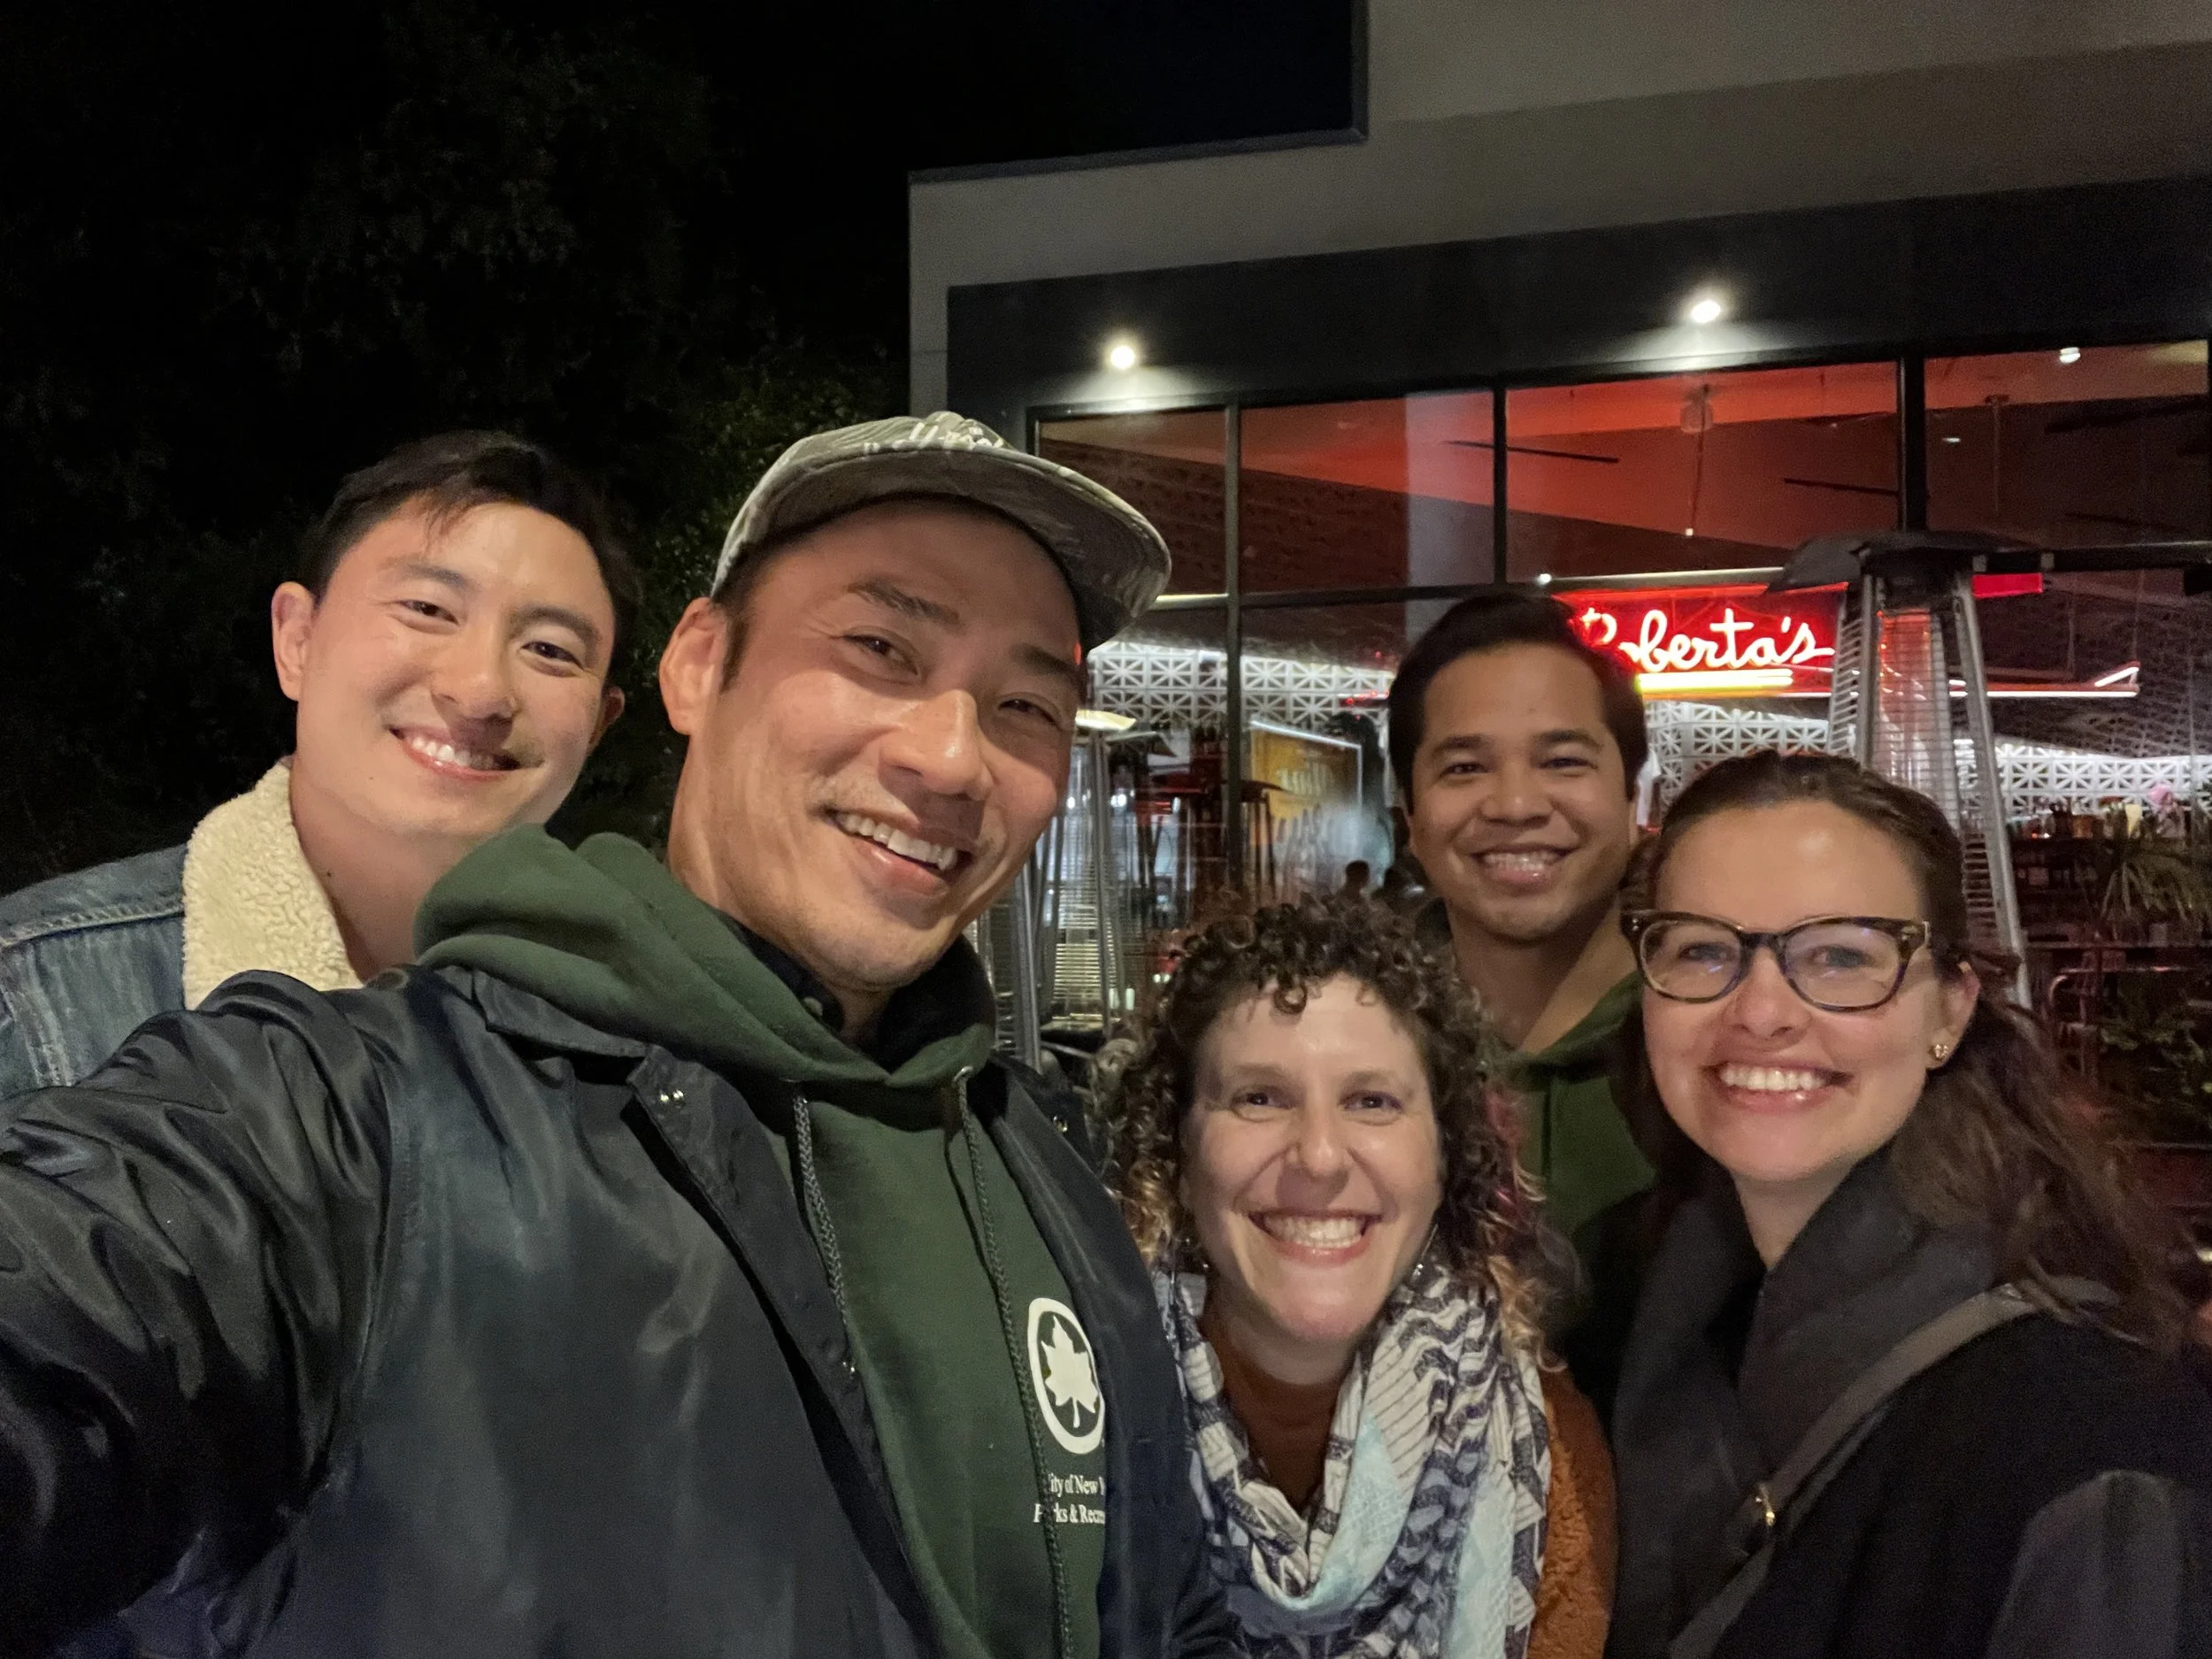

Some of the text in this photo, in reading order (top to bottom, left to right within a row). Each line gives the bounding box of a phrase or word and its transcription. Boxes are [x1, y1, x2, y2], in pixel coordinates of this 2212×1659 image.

[1048, 1472, 1064, 1498] ity
[1064, 1474, 1074, 1494] of
[1074, 1475, 1098, 1494] New
[1033, 1502, 1068, 1523] Pks
[1070, 1504, 1079, 1523] &
